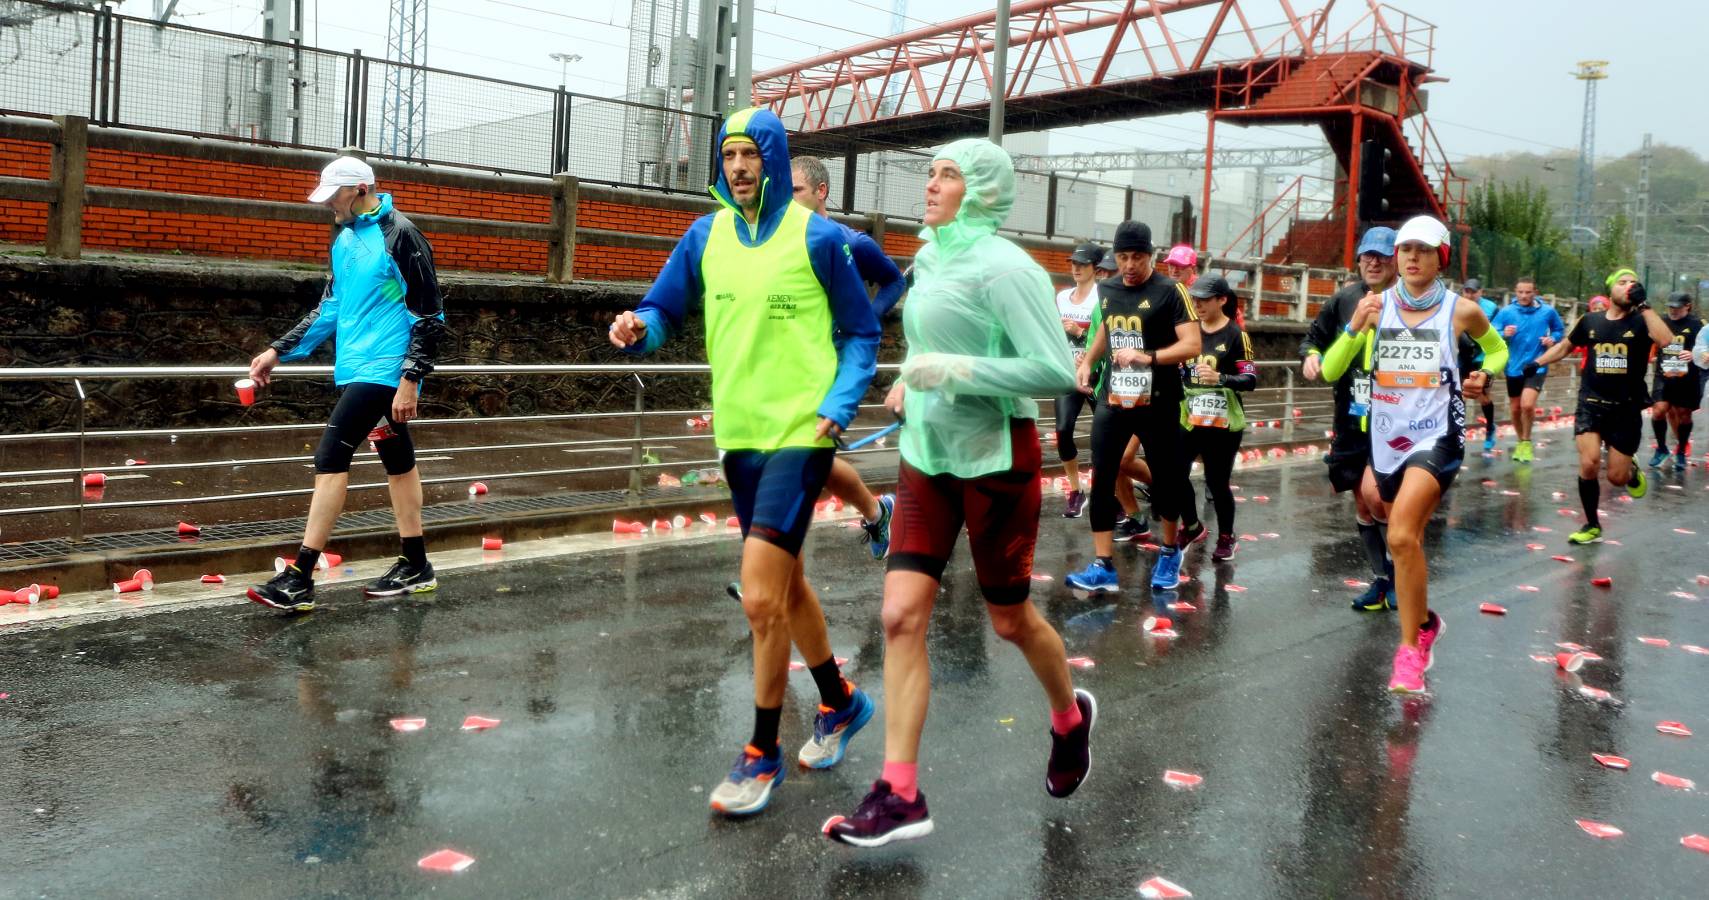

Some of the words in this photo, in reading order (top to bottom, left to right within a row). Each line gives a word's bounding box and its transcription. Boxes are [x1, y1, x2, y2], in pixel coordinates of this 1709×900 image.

[1110, 336, 1144, 349] BEHOBIA
[1380, 345, 1434, 360] 22735
[1111, 376, 1148, 388] 21680
[1355, 383, 1370, 394] 17
[1193, 397, 1228, 409] 21522
